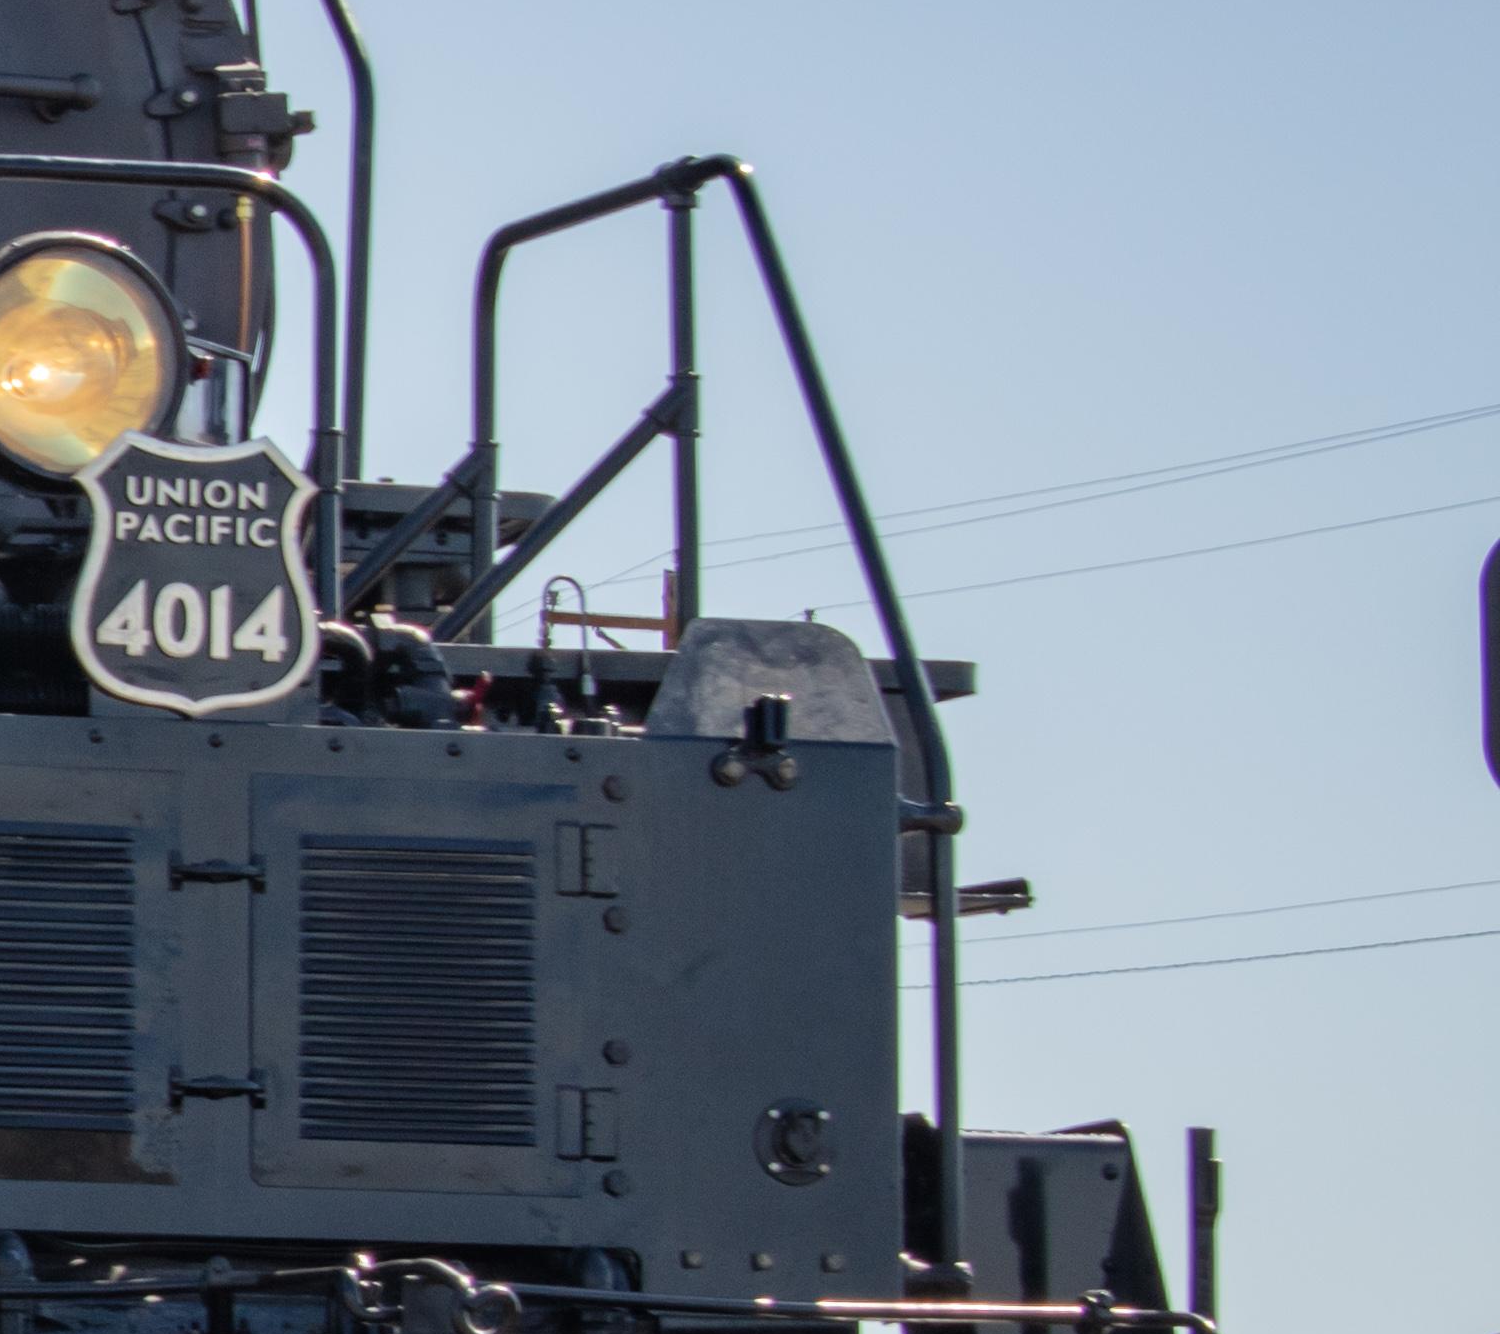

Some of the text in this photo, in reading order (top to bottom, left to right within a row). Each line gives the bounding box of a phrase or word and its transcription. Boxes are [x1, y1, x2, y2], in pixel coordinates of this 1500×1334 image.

[125, 474, 269, 511] UNION
[114, 511, 278, 548] PACIFIC
[97, 578, 289, 663] 4014
